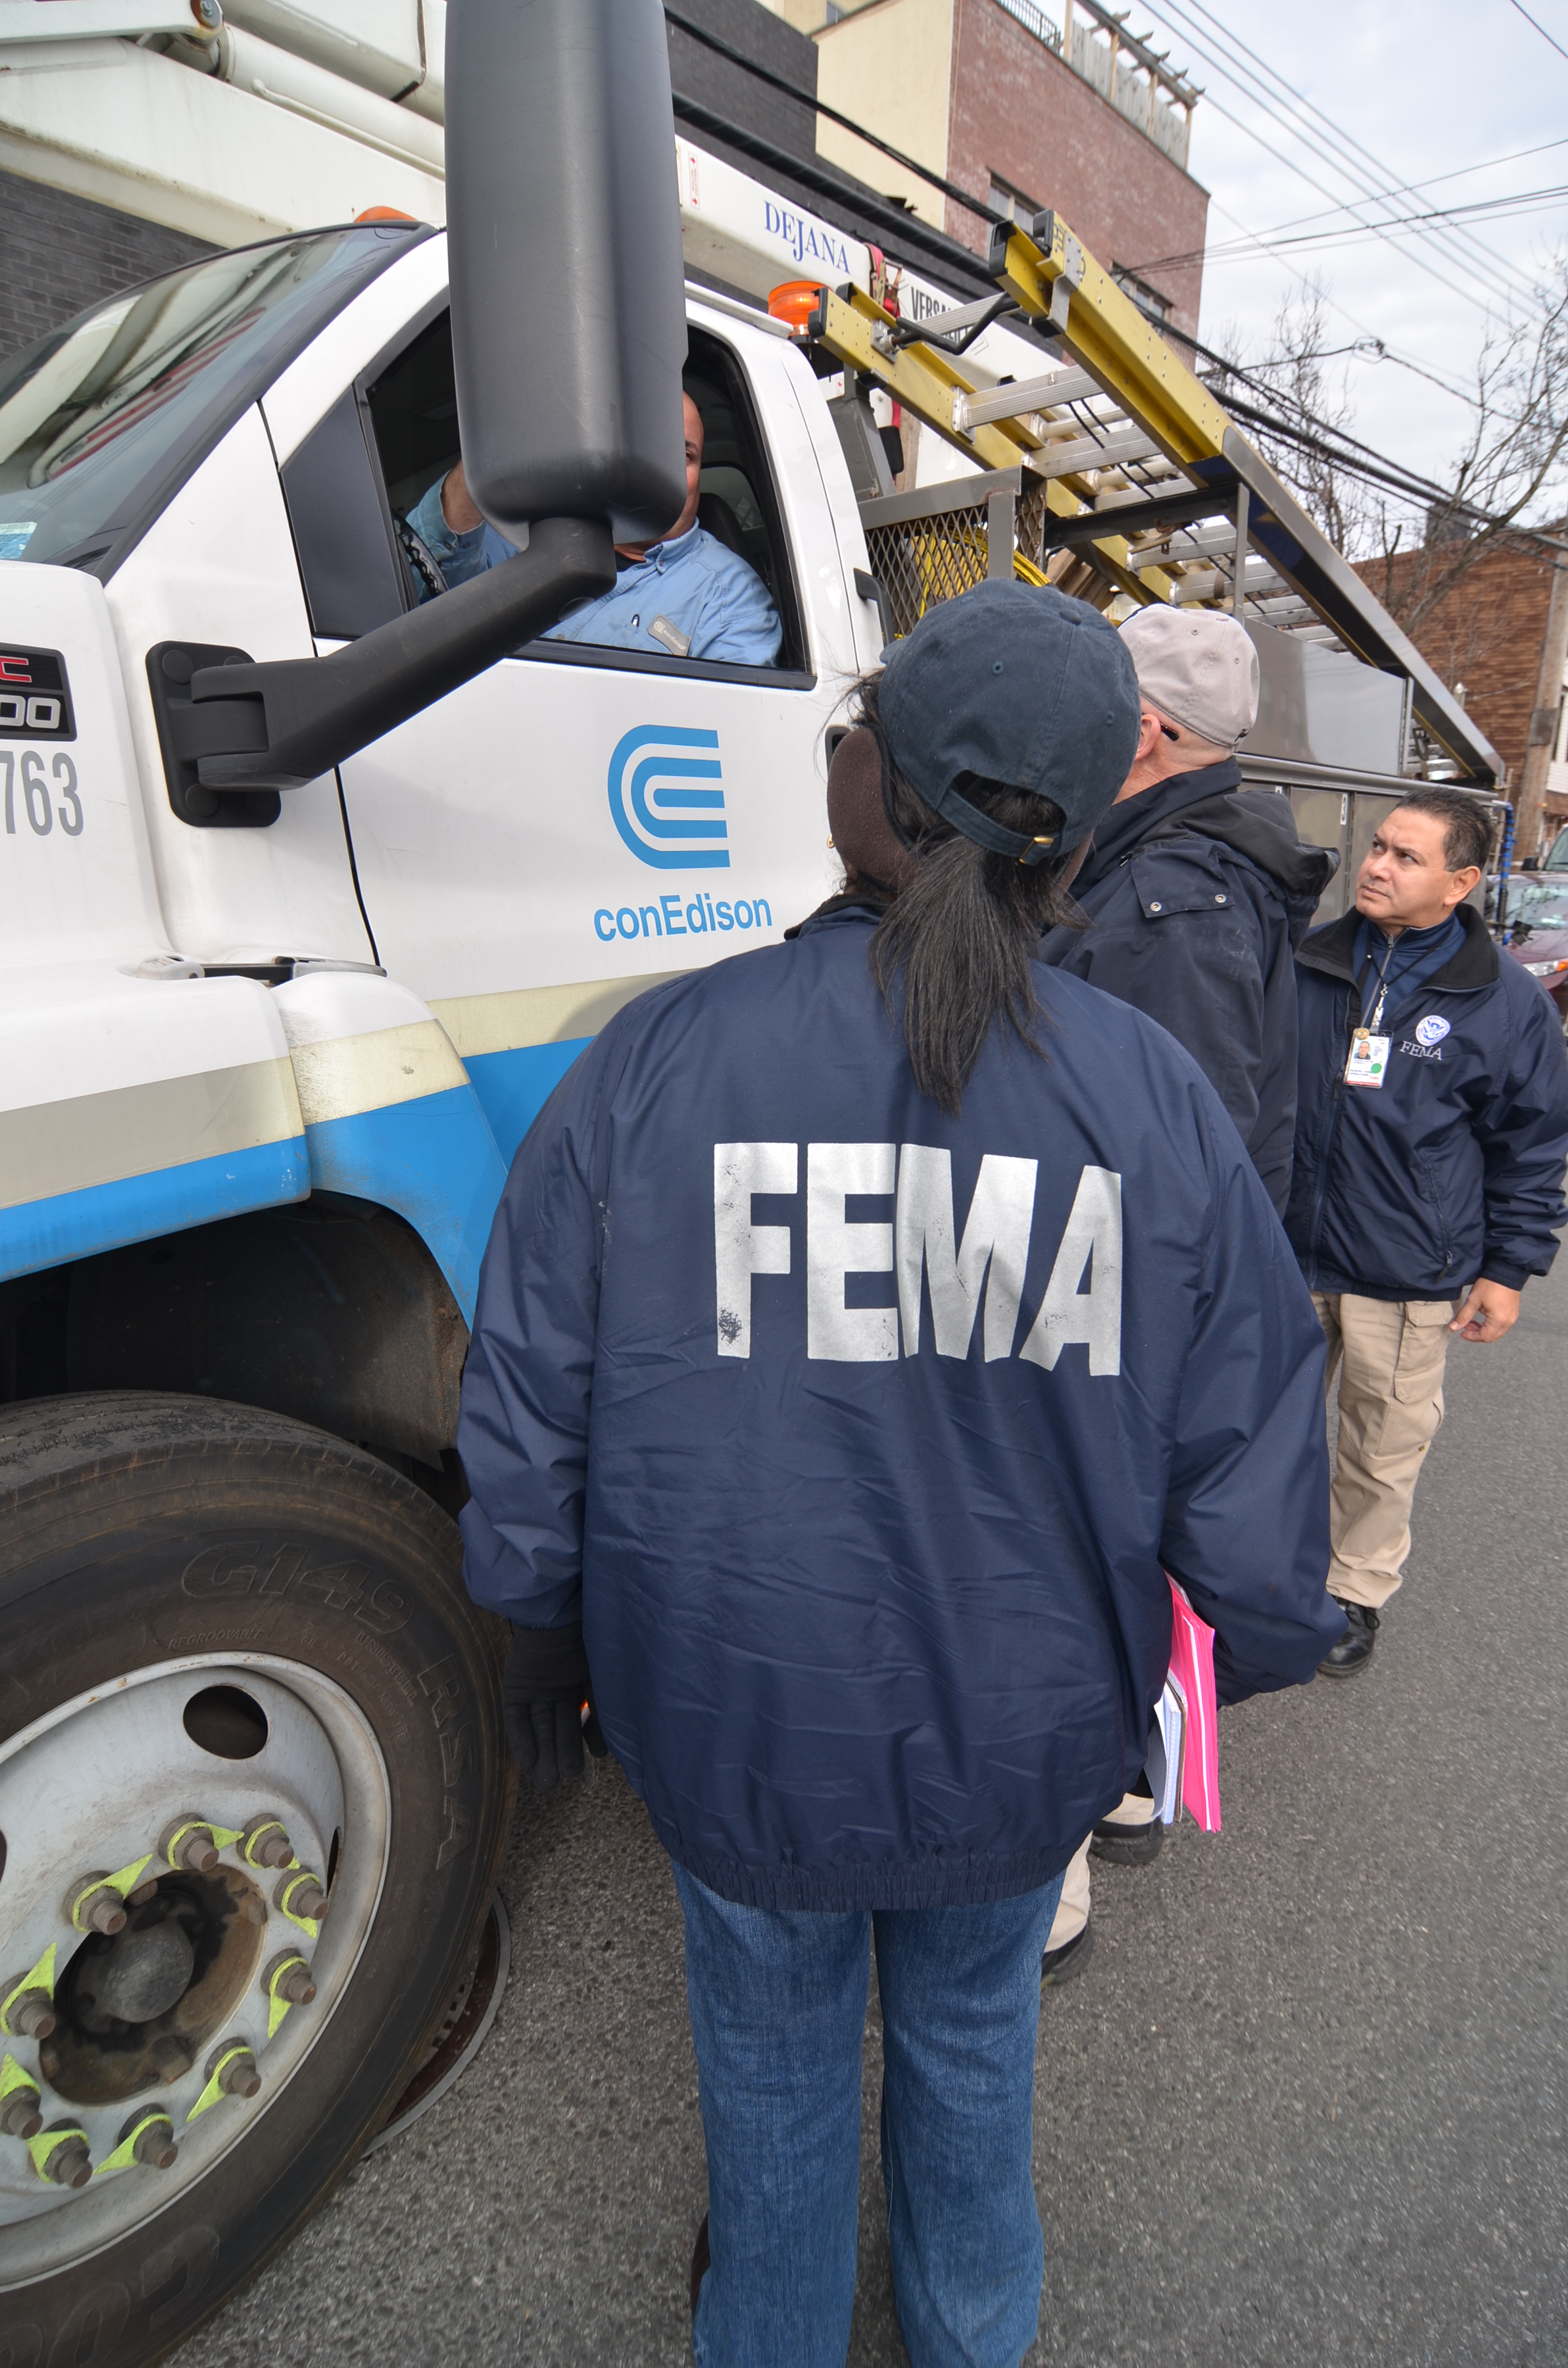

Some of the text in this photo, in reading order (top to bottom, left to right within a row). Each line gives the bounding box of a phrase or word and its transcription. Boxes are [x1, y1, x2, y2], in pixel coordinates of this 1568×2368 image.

[764, 200, 851, 275] DEJANA
[0, 750, 84, 837] 763
[594, 892, 772, 942] conEdison
[1399, 1040, 1442, 1061] FEMA
[713, 1142, 1123, 1377] FEMA
[181, 1541, 417, 1634] G149
[167, 1628, 266, 1650] REGROOVABLE
[355, 1631, 418, 1707] UNISTEEL
[416, 1652, 478, 1871] RSA
